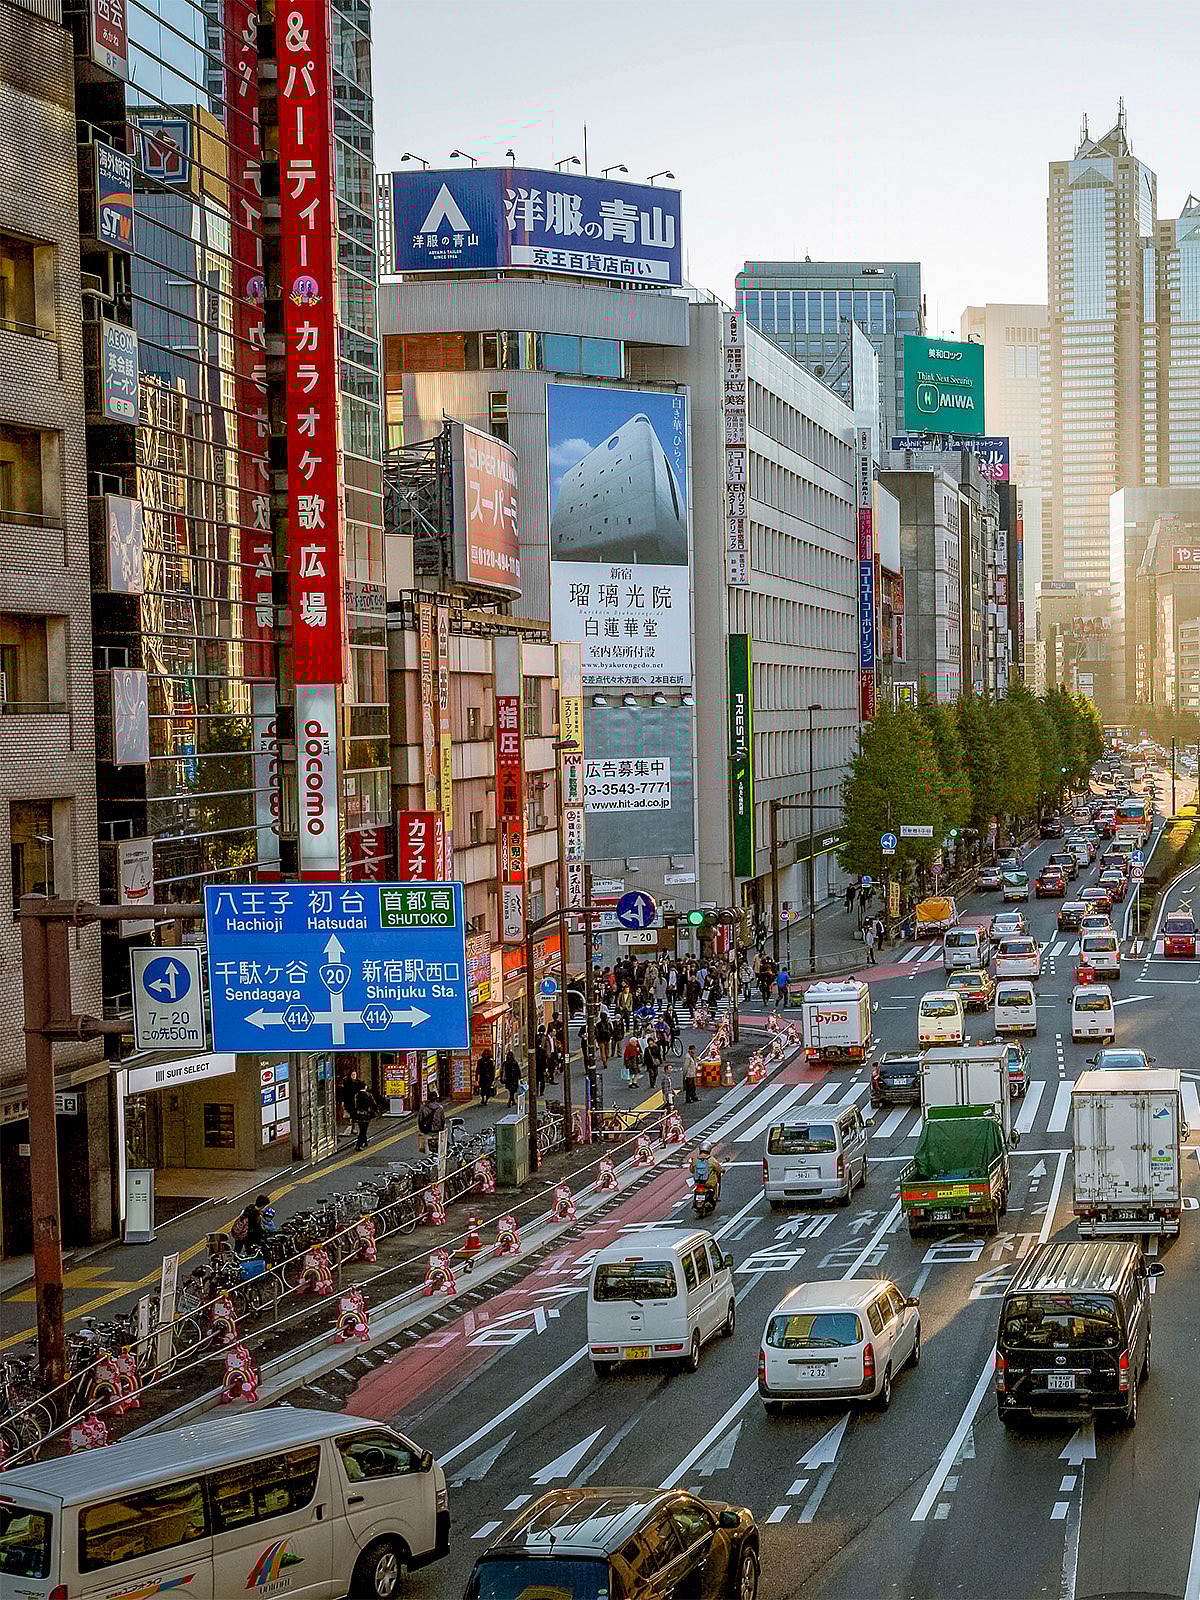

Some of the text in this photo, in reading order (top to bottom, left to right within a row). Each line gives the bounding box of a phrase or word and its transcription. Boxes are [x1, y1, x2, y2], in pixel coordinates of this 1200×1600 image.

[99, 147, 131, 181] 海外旅行
[504, 188, 676, 249] 洋服の青山
[413, 234, 480, 249] 洋服の青山
[533, 248, 652, 276] 京王百貨店向い
[108, 328, 133, 354] AEON
[928, 348, 963, 360] 美和ロック
[108, 352, 134, 377] 英会話
[106, 373, 137, 396] イーオン
[917, 371, 973, 386] Think Next Security
[725, 381, 745, 393] 共立
[725, 395, 745, 406] 美容
[940, 394, 975, 409] MIWA
[469, 448, 496, 478] SUPER
[296, 321, 328, 628] カラオケ歌広場
[727, 484, 746, 492] KEN
[610, 567, 632, 580] 新宿
[569, 583, 672, 609] 瑠璃光院
[585, 617, 658, 637] 白蓮華堂
[589, 645, 655, 658] 室内墓所付設
[650, 675, 684, 685] 2本目右折
[499, 706, 519, 753] 指圧
[564, 756, 582, 765] KM
[586, 759, 665, 778] 広告募集中
[304, 720, 328, 836] docomo
[591, 799, 670, 810] www.hit-ad.co.jp
[214, 890, 294, 915] 八王子
[307, 889, 365, 914] 初台
[383, 890, 450, 911] 首都高
[226, 917, 283, 933] Hachioji
[307, 916, 368, 930] Hatsudai
[388, 913, 447, 925] SHUTOKO
[326, 969, 345, 985] 20
[362, 959, 460, 984] 新宿駅西口
[225, 987, 301, 1003] Sendagaya
[366, 984, 458, 1001] Shinjuku Sta.
[287, 1011, 310, 1025] 414
[366, 1010, 388, 1024] 414
[816, 1013, 848, 1025] DyDo
[142, 1026, 199, 1041] この先50m
[166, 1062, 210, 1079] SUIT SELECT
